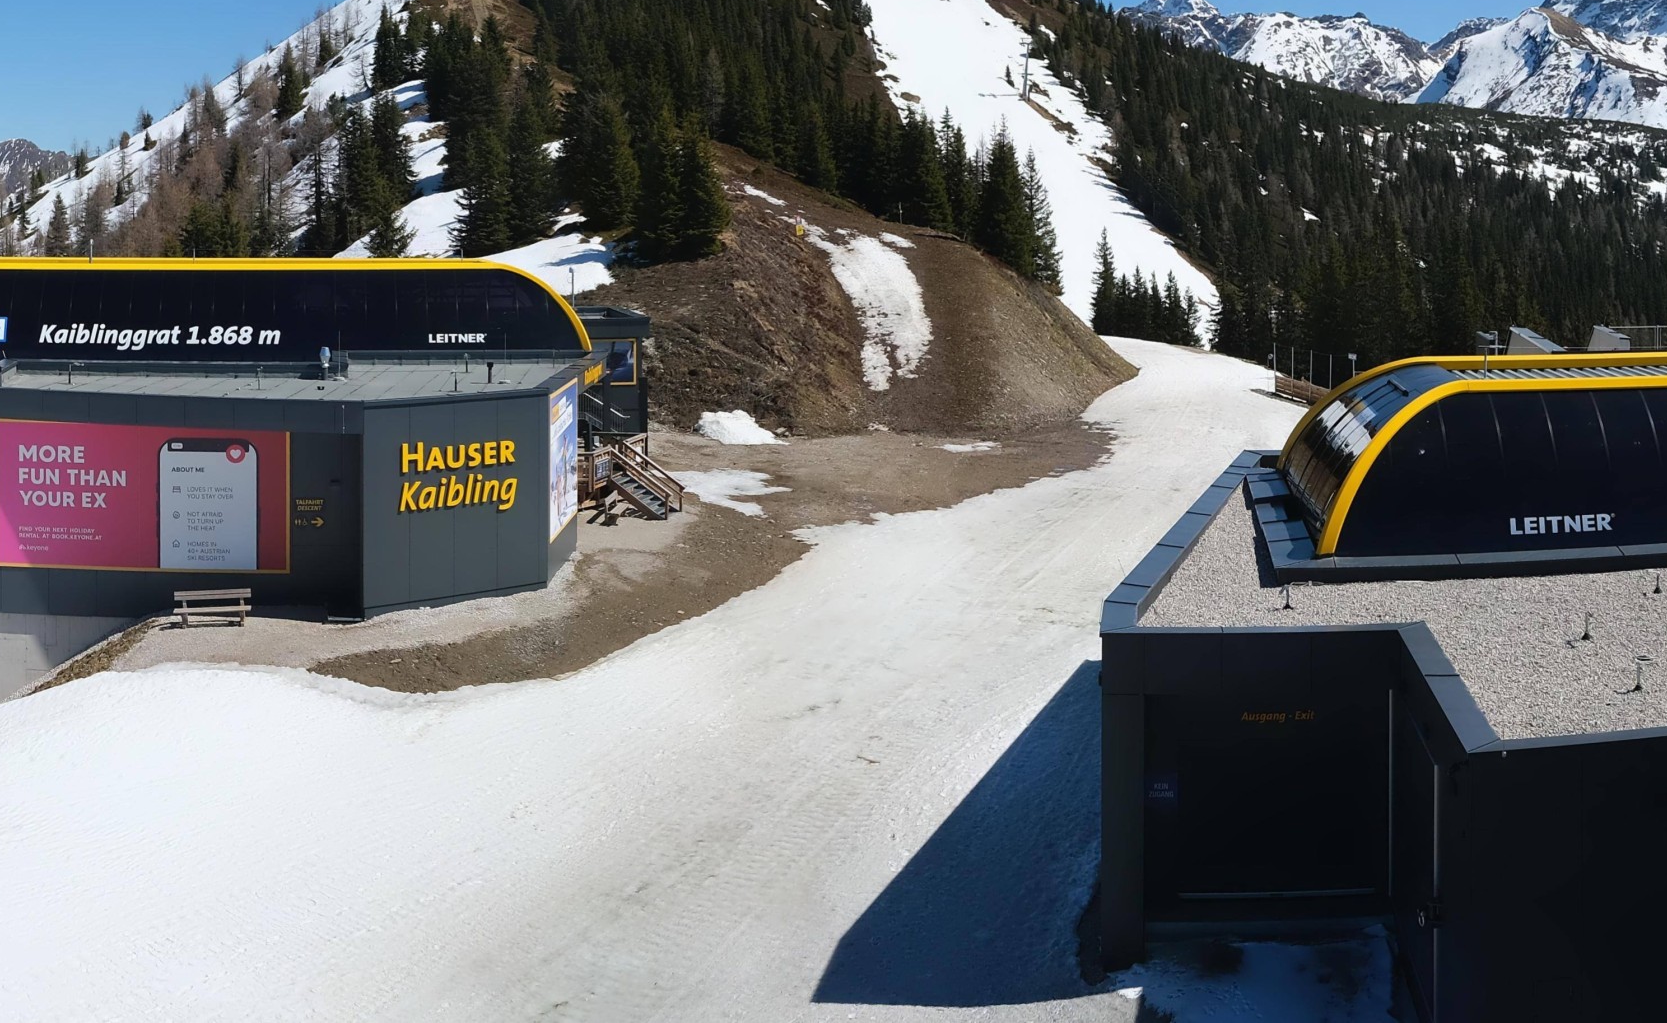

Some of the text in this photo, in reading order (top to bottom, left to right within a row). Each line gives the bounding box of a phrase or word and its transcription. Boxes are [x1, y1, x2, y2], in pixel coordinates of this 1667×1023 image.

[39, 323, 281, 351] Kaiblinggrat 1.868 m
[18, 444, 85, 464] MORE
[18, 468, 127, 487] FUN THAN
[20, 490, 107, 509] YOUR EX
[400, 473, 518, 512] Kaibling
[26, 544, 49, 552] keyone
[1241, 710, 1287, 724] Ausgang
[1295, 710, 1316, 721] Exit
